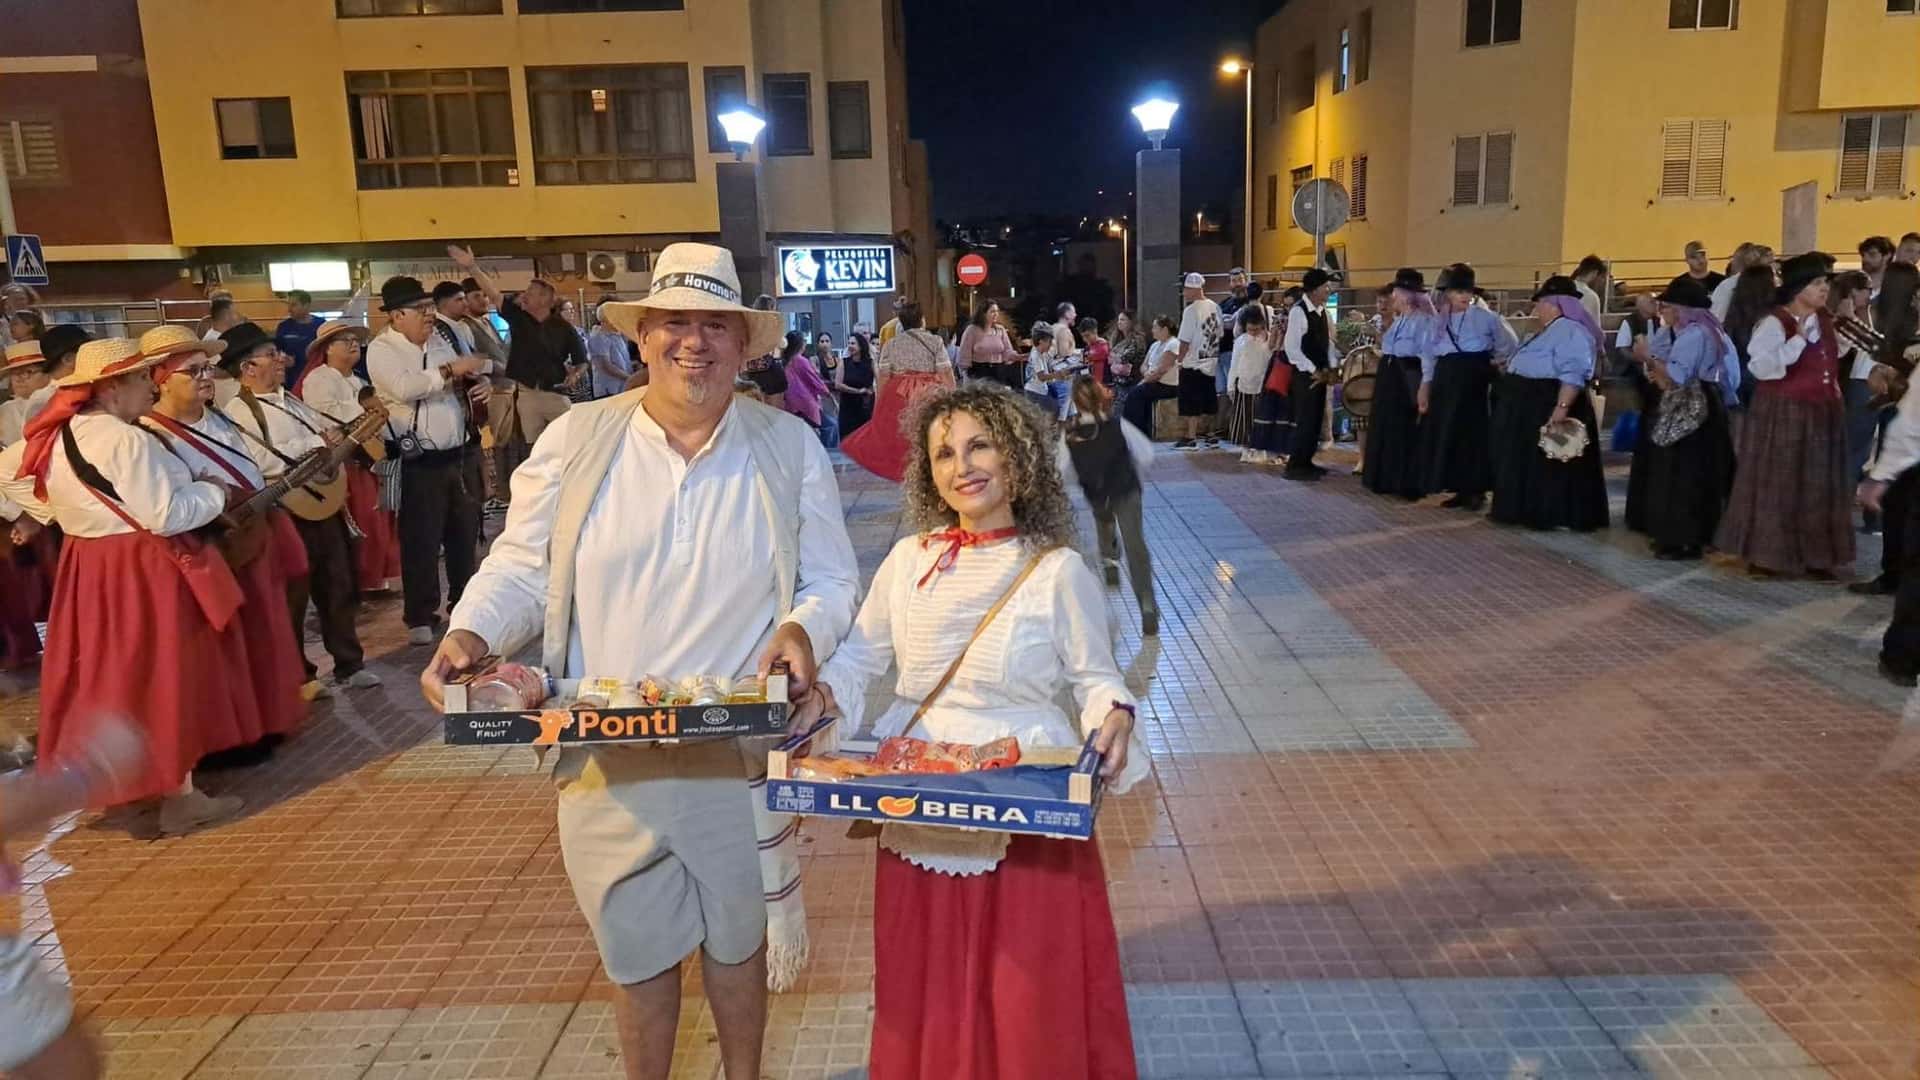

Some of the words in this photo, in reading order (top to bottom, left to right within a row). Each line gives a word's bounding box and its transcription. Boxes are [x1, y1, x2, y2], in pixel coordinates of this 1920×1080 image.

[825, 260, 886, 281] KEVIN
[469, 719, 513, 729] QUALITY
[579, 708, 676, 737] Ponti
[476, 728, 507, 738] FRUIT
